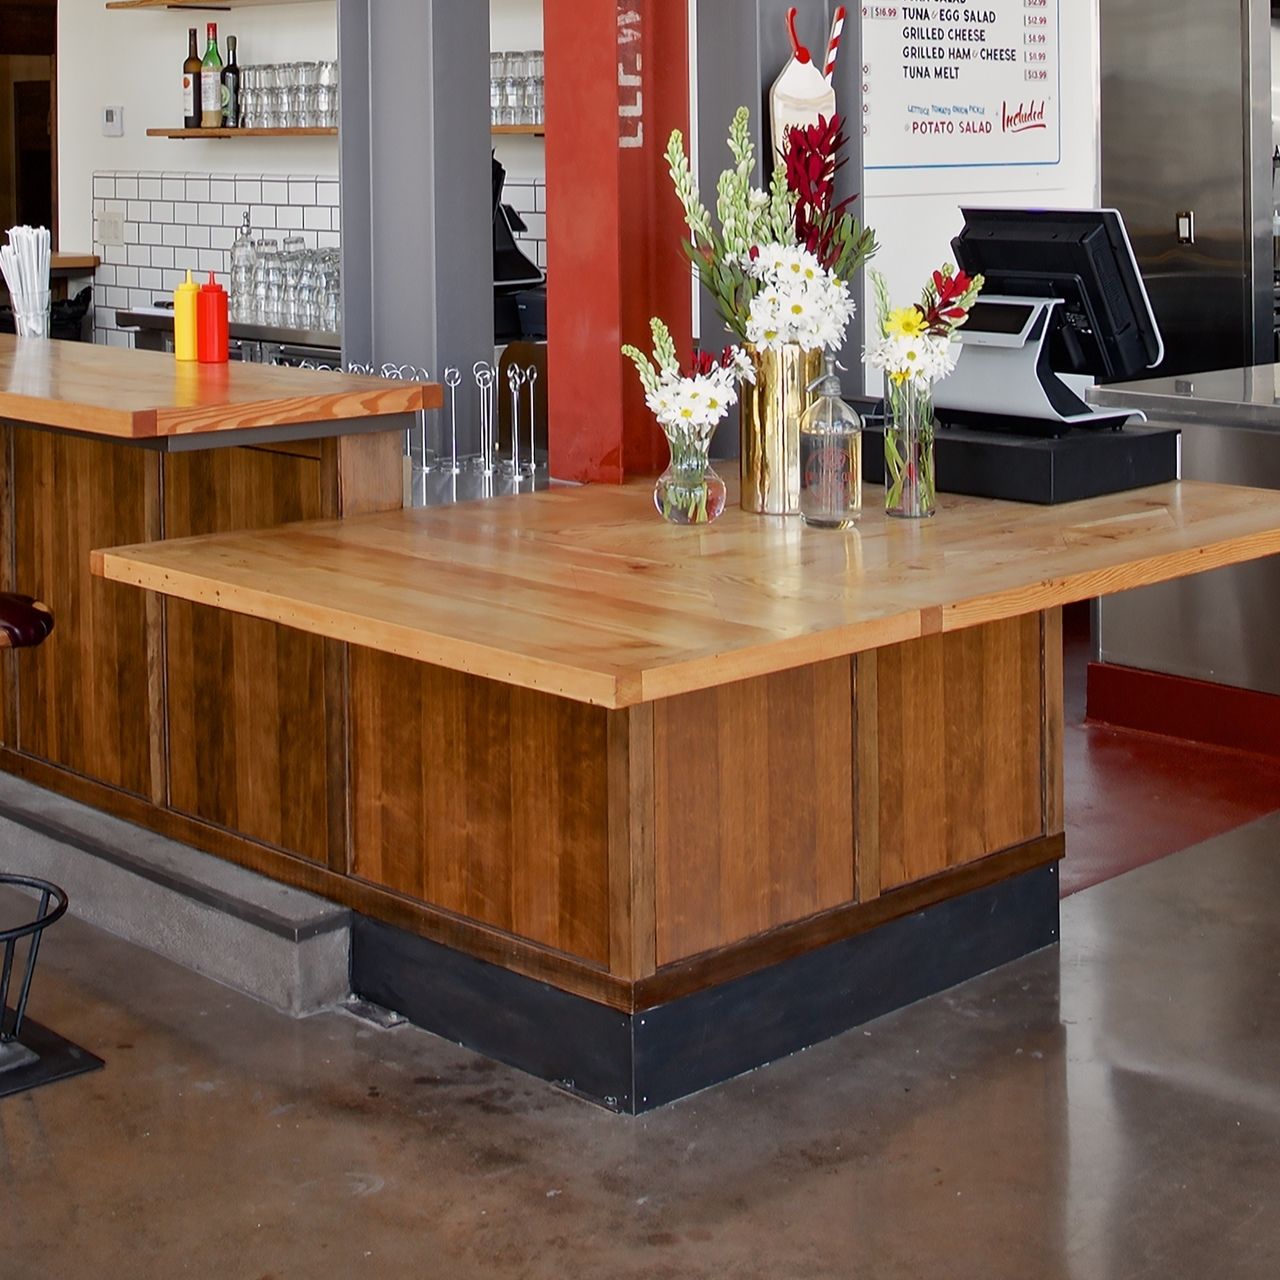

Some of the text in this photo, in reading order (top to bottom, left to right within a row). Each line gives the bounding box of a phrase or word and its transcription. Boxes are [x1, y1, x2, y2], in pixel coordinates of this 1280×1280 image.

[902, 7, 996, 23] TUNA EGG SALAD
[903, 27, 986, 42] GRILLED CHEESE
[903, 46, 1016, 61] GRILLED HAM CHEESE
[903, 66, 959, 79] TUNA MELT
[1002, 100, 1044, 133] Included
[912, 121, 992, 134] POTATO SALAD
